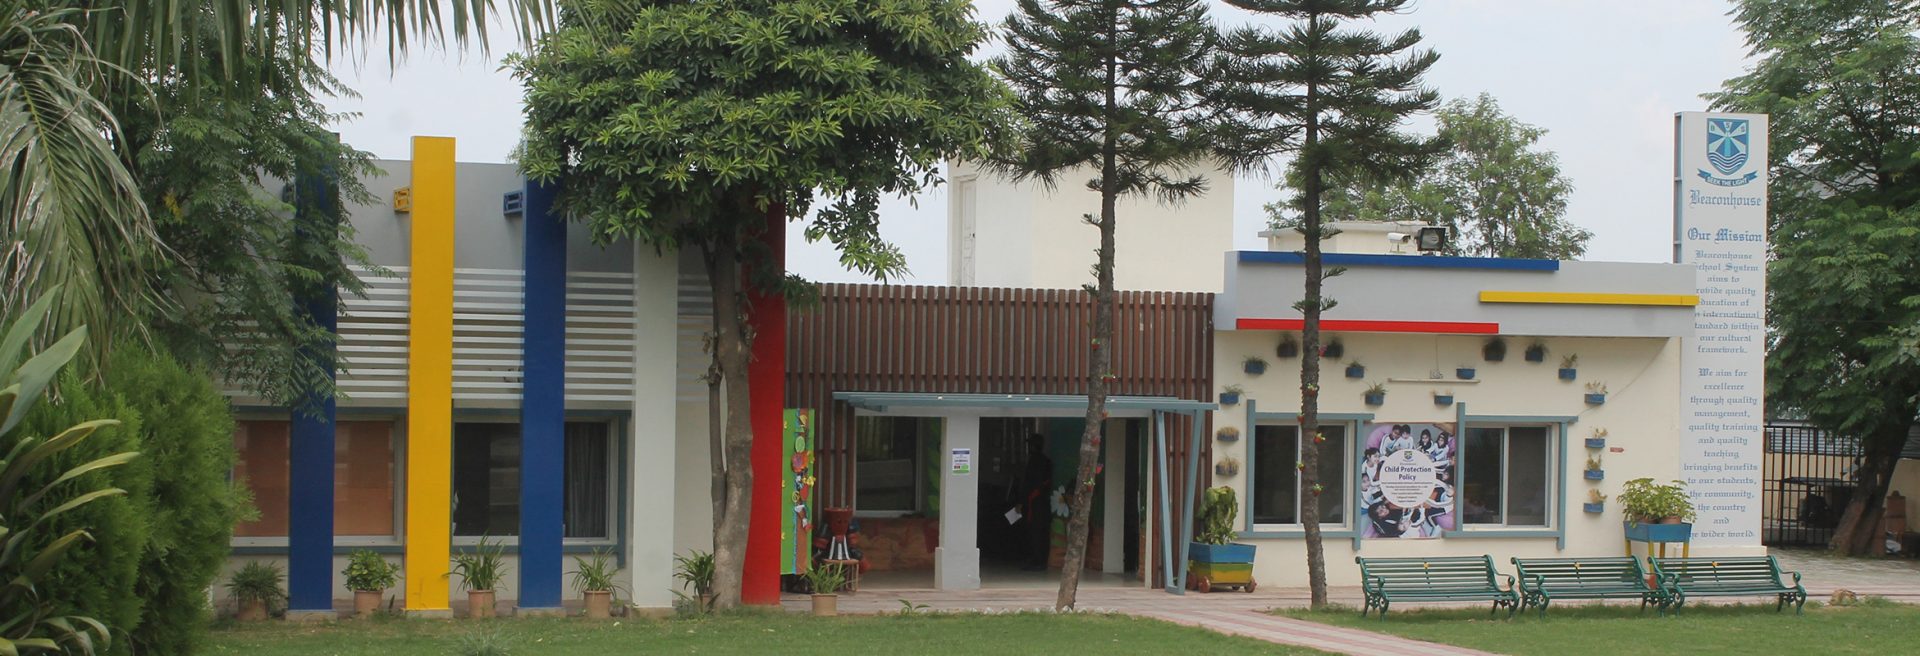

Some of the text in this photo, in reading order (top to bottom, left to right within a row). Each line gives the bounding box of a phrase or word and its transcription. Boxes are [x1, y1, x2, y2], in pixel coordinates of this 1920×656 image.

[1689, 189, 1762, 208] Beaconhouse
[1687, 227, 1762, 243] Our Mission
[1695, 250, 1752, 261] Beaconhouse
[1693, 262, 1759, 272] chool System
[1725, 287, 1756, 296] quality
[1700, 298, 1738, 306] ducation
[1731, 322, 1759, 331] within
[1718, 334, 1752, 342] cultural
[1698, 367, 1713, 377] We
[1734, 369, 1748, 377] for
[1690, 395, 1757, 405] through quality
[1694, 410, 1751, 419] management,
[1688, 423, 1758, 432] quality training
[1717, 436, 1748, 445] quality
[1703, 450, 1740, 459] teaching
[1683, 463, 1758, 472] bringing benefits
[1717, 477, 1757, 485] students,
[1689, 490, 1755, 499] the community,
[1697, 504, 1746, 512] the country
[1700, 530, 1726, 538] wider
